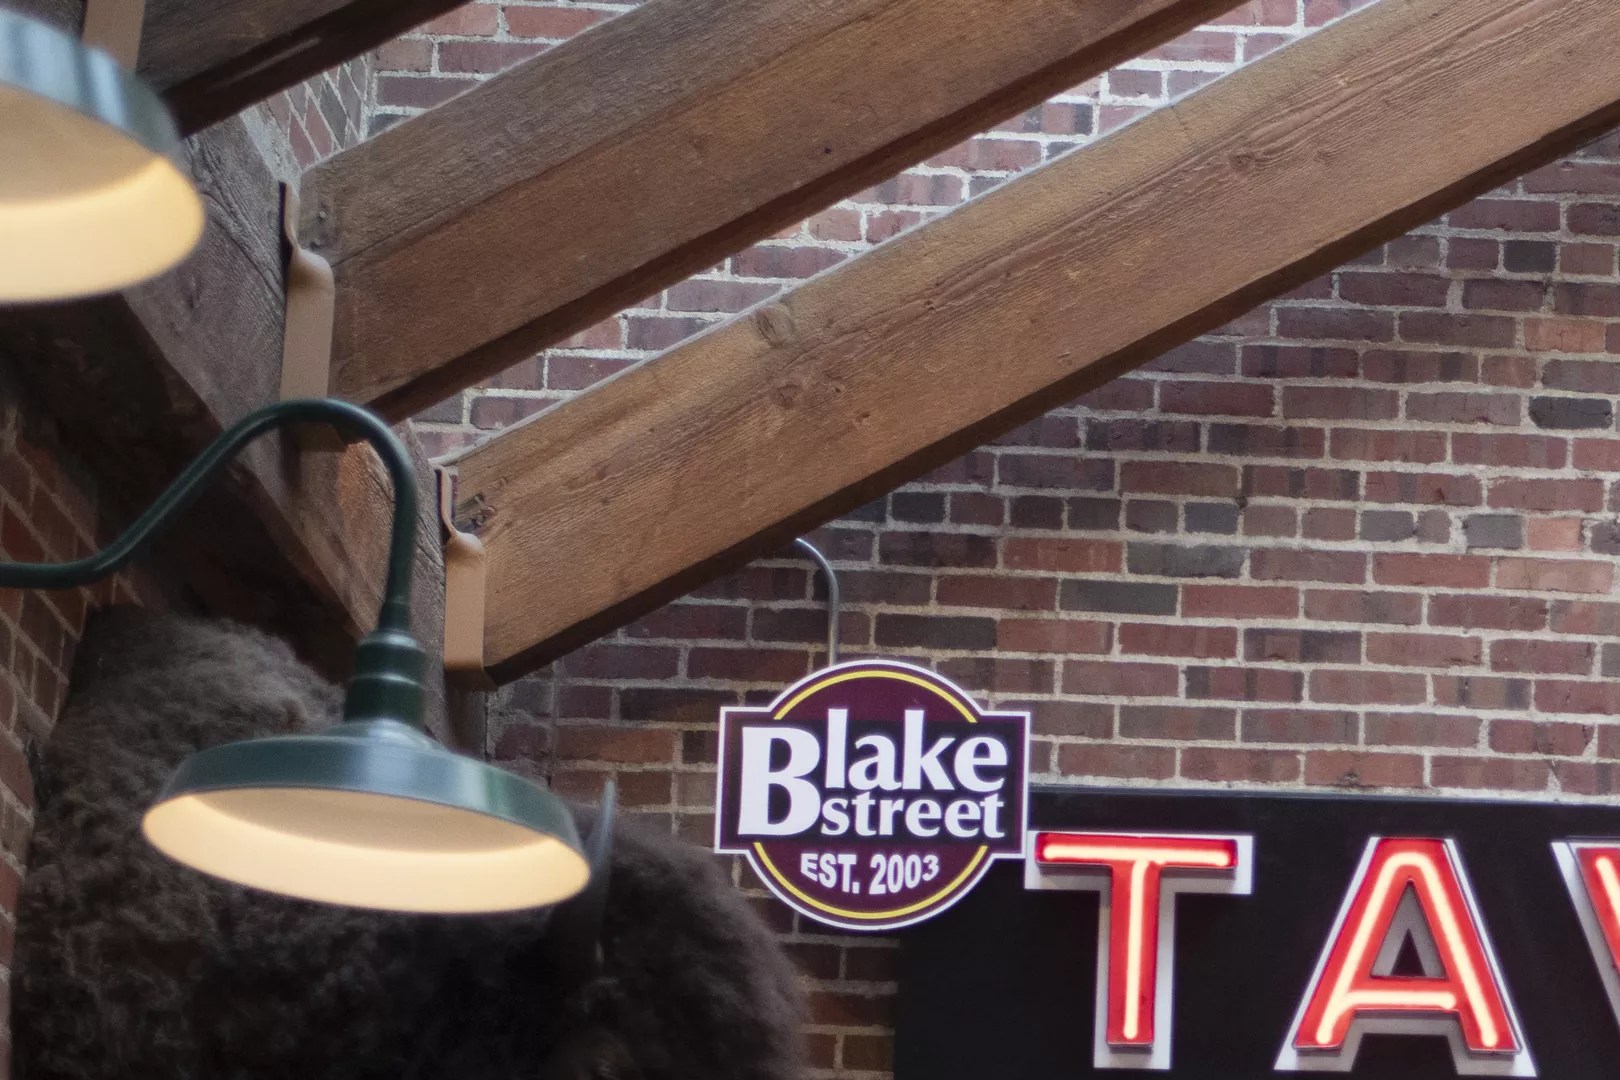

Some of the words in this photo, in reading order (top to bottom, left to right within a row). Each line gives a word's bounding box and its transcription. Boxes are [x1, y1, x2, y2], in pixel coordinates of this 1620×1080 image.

[738, 708, 1008, 836] Blake
[820, 791, 1006, 839] street
[800, 853, 861, 894] EST.
[869, 854, 940, 896] 2003
